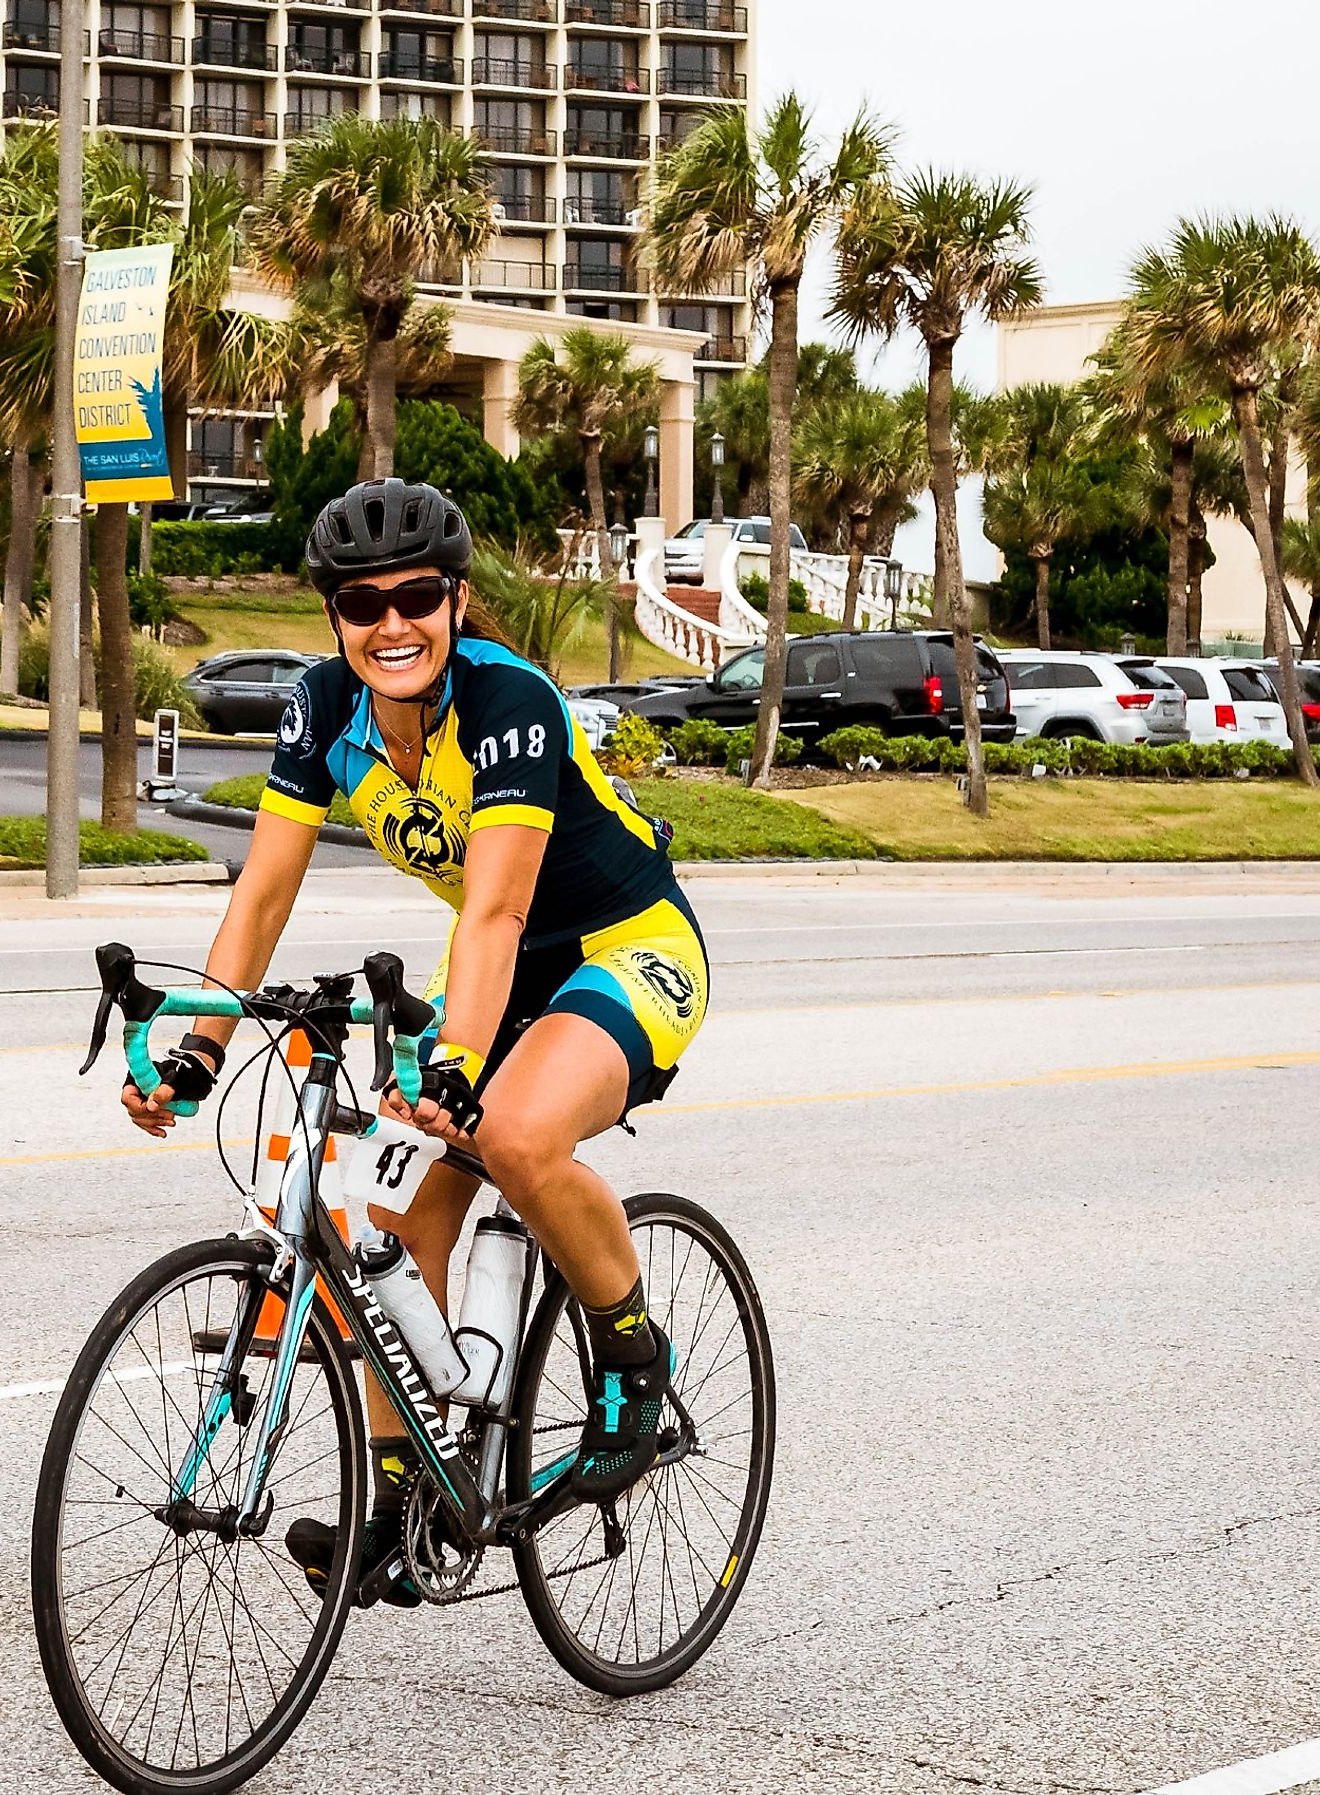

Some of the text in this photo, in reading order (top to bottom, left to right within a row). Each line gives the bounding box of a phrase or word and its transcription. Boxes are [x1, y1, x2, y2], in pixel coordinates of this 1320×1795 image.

[86, 265, 157, 293] GALVESTON
[82, 302, 126, 325] ISLAND
[79, 333, 156, 359] CONVENTION
[78, 369, 122, 393] CENTER
[79, 403, 131, 428] DISTRICT
[83, 456, 98, 465] THE
[100, 454, 119, 464] SAN
[119, 453, 139, 463] LUIS
[375, 1140, 420, 1189] 43
[341, 1264, 460, 1460] SPECIALIZED
